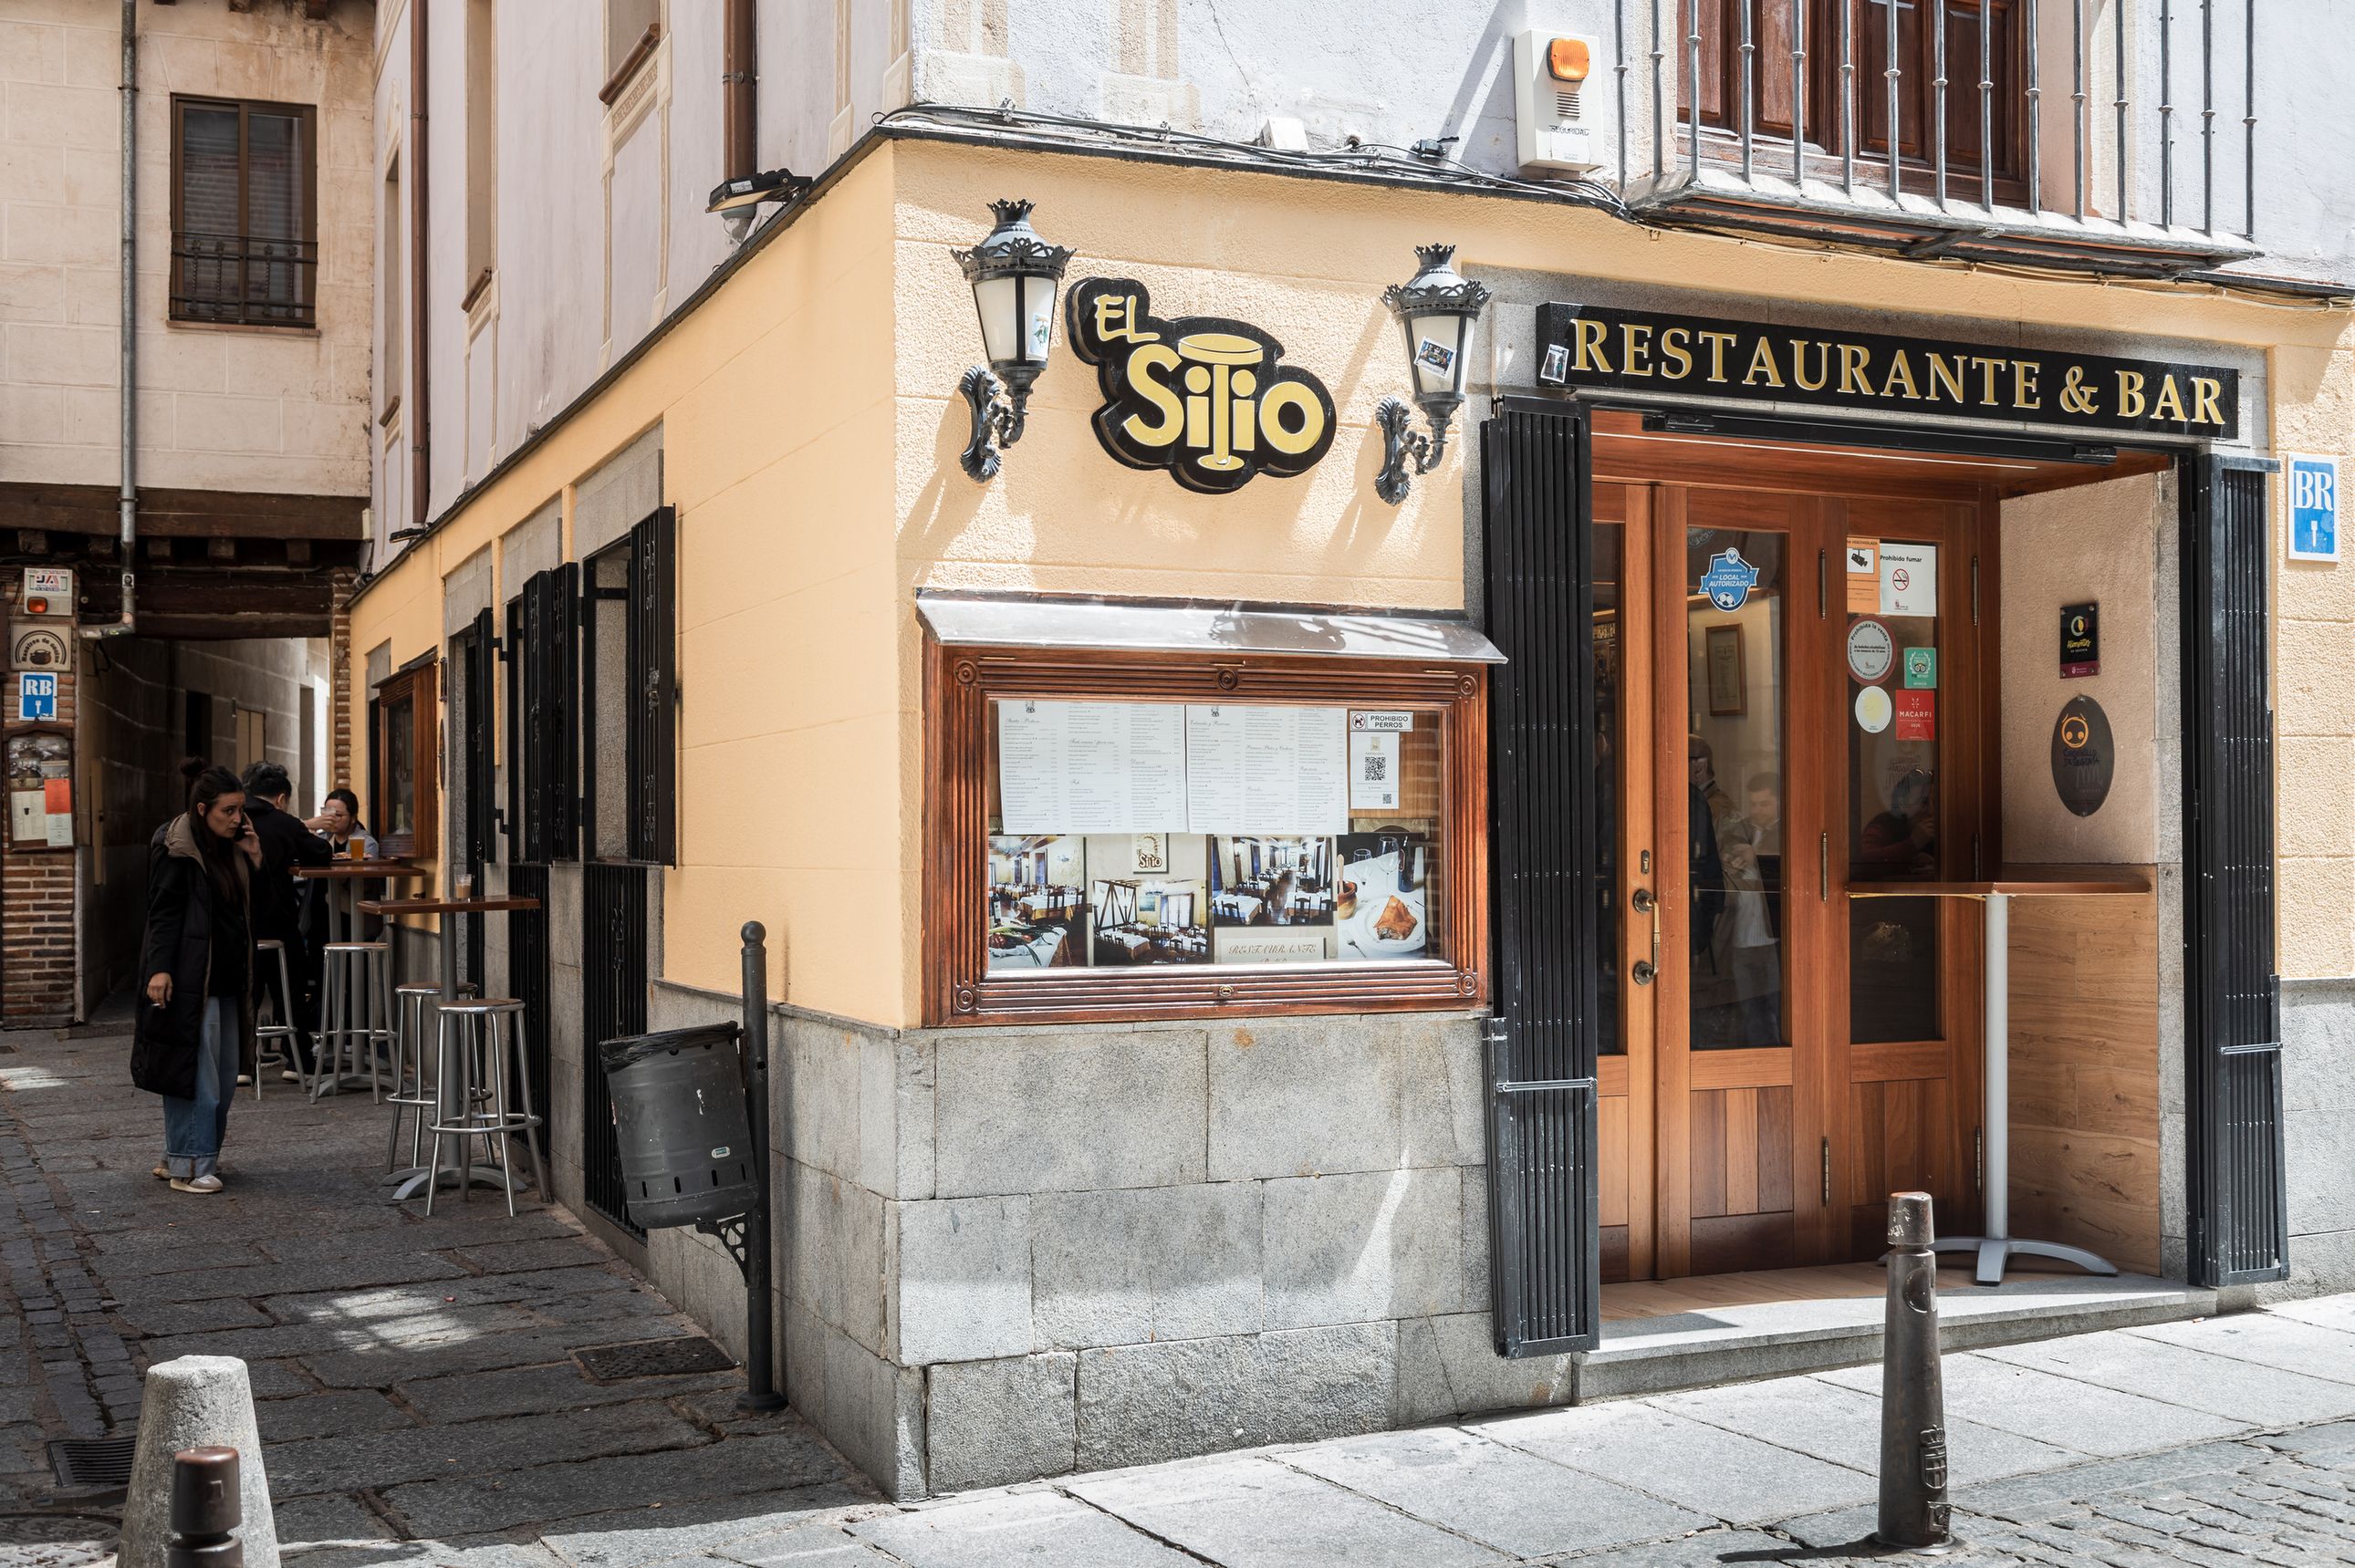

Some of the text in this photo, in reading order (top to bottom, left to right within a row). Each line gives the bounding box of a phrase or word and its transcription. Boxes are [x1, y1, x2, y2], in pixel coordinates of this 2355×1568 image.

[1094, 294, 1160, 343] EL
[1570, 318, 2225, 425] RESTAURANTE & BAR
[2294, 470, 2334, 512] BR
[1880, 555, 1905, 563] Prohibido
[1850, 623, 1871, 641] Prohibida
[1878, 627, 1889, 642] venta
[25, 679, 52, 696] RB
[1227, 944, 1317, 955] RESTAURANTE
